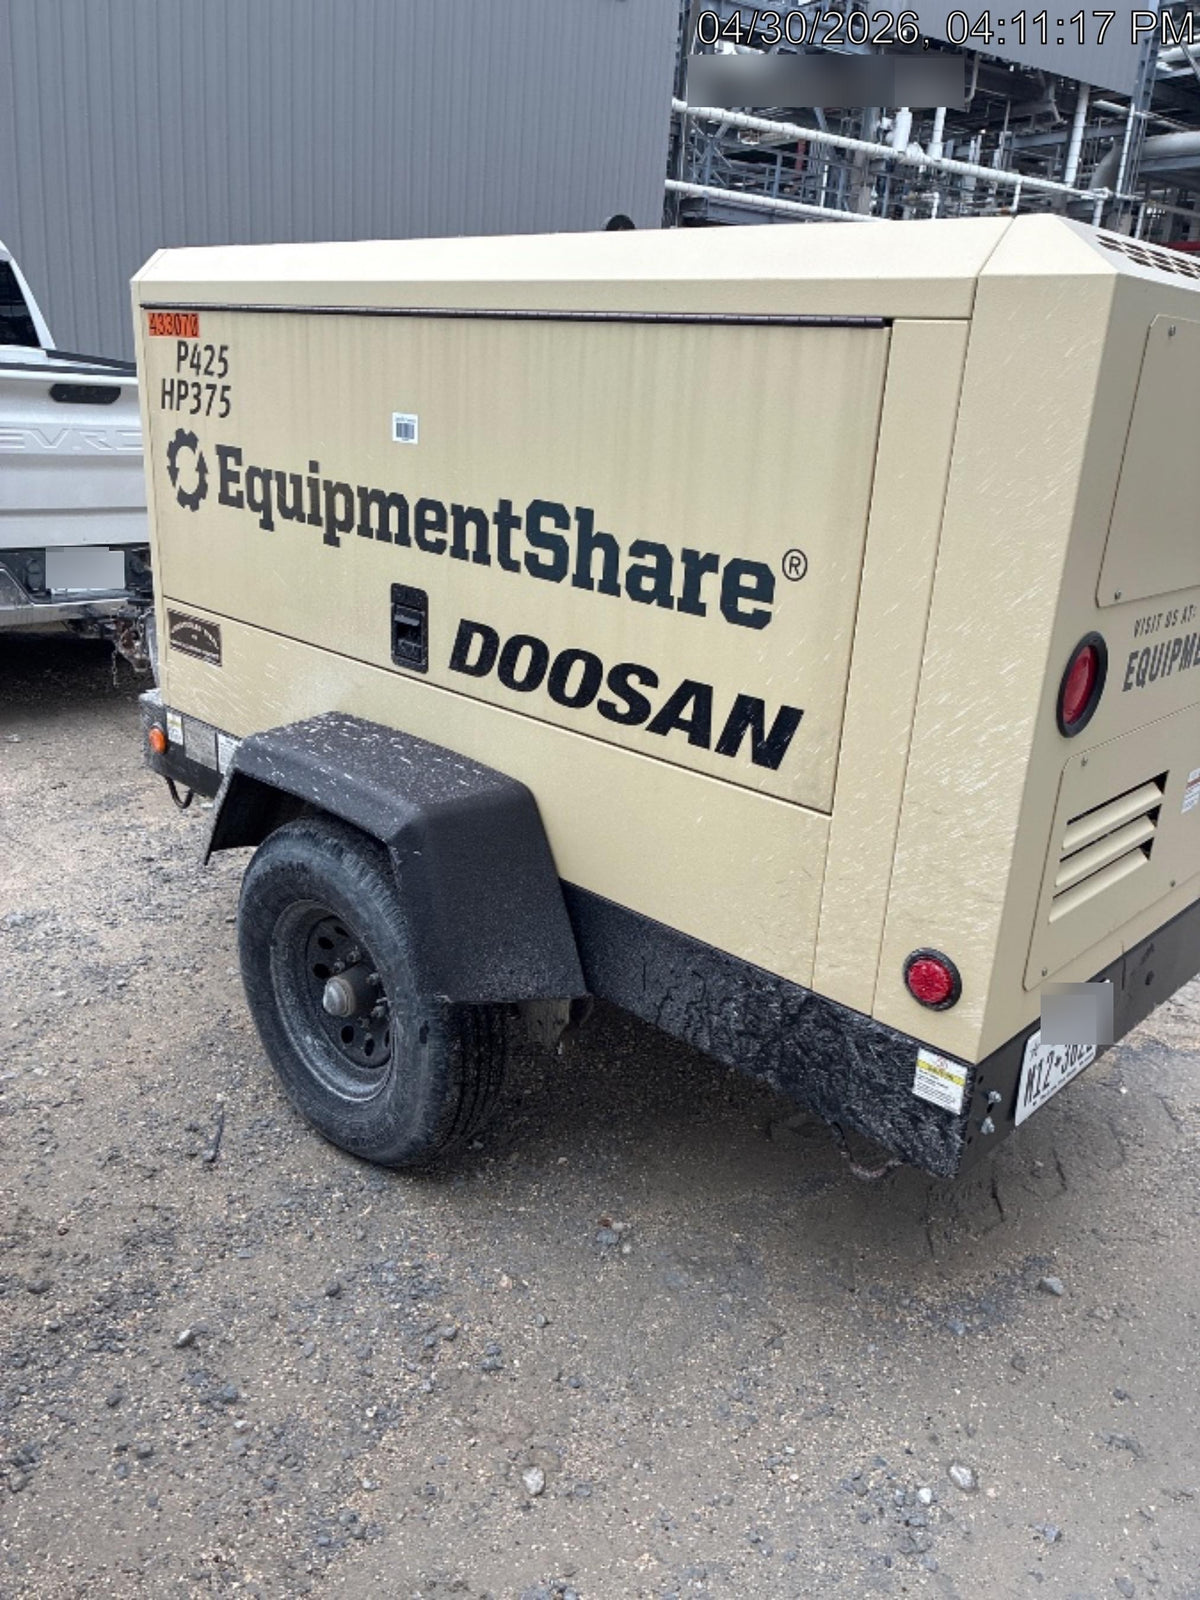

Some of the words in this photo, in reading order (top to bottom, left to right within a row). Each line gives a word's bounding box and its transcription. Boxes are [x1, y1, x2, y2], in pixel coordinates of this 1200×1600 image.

[176, 340, 229, 379] P425
[161, 378, 231, 418] HP375
[1134, 612, 1164, 638] VISIT
[1164, 608, 1180, 628] US
[448, 619, 804, 770] DOOSAN
